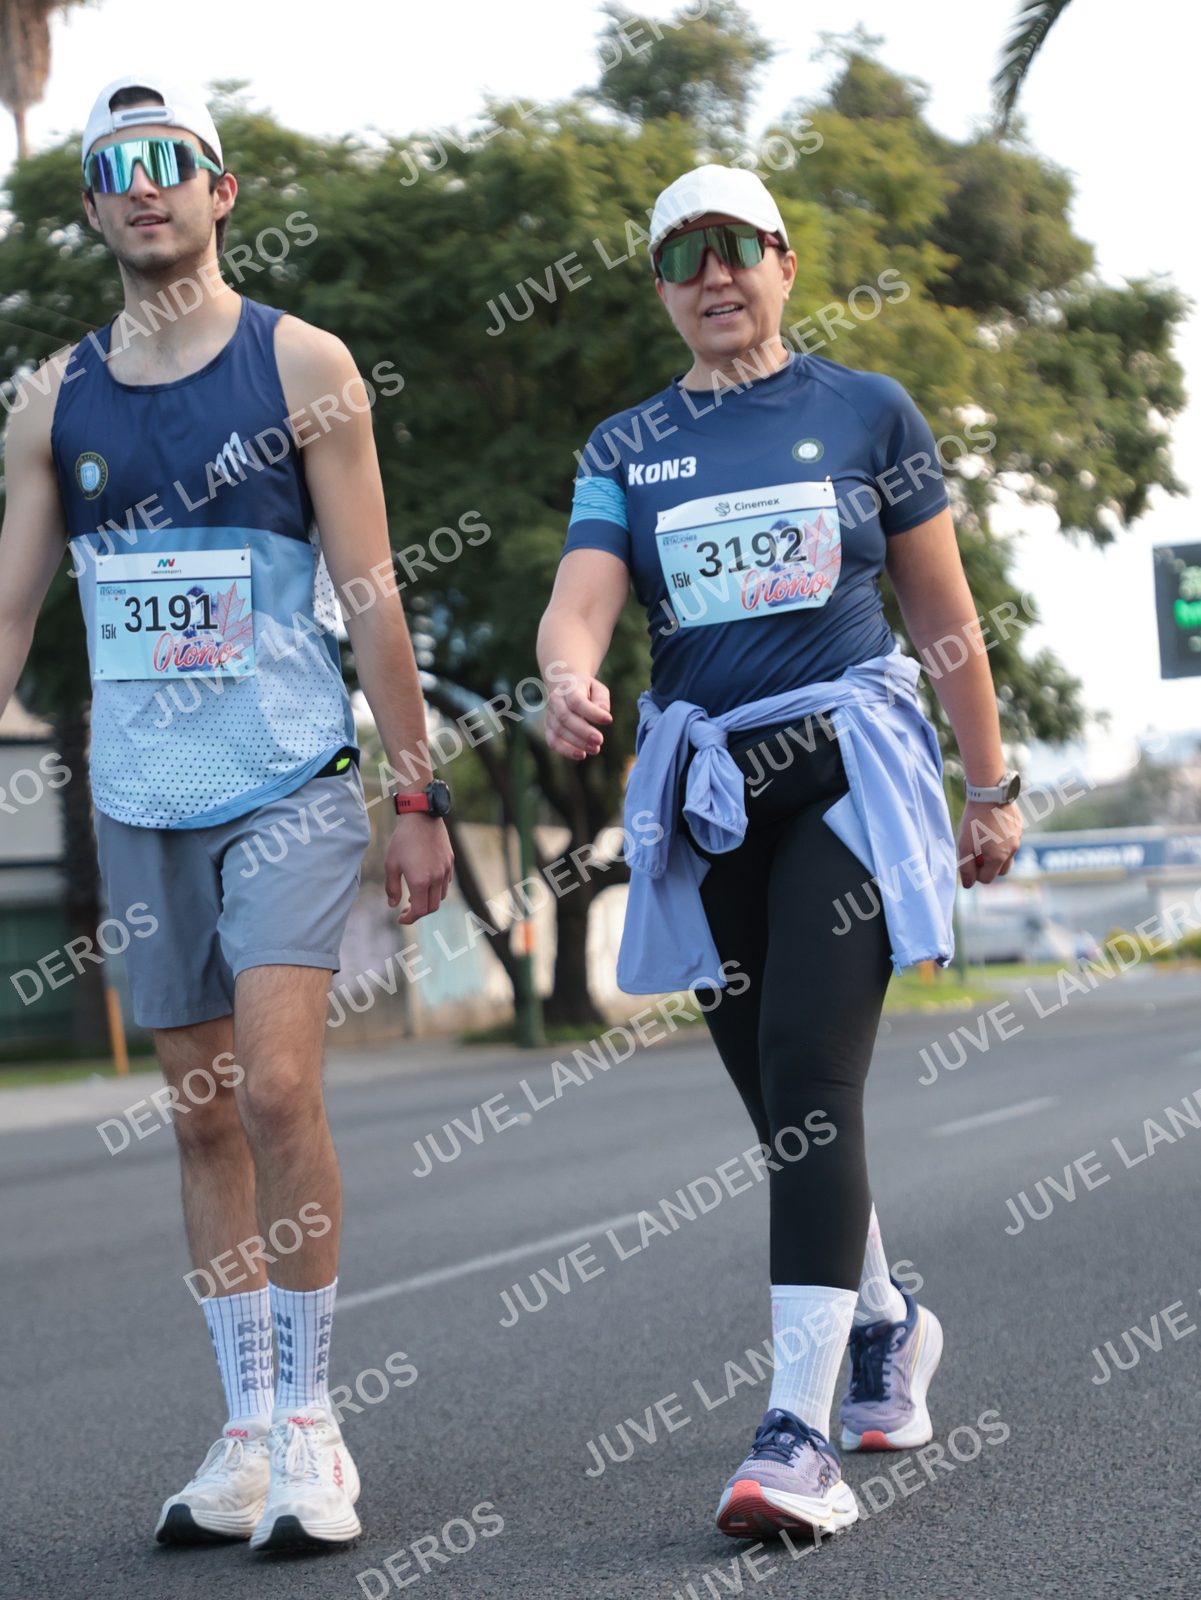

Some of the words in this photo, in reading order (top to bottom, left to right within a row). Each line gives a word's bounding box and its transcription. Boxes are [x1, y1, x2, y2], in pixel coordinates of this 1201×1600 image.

[628, 456, 697, 486] KON3
[734, 497, 780, 511] Cinemex
[696, 527, 807, 578] 3192
[671, 572, 692, 589] 15k
[124, 594, 218, 633] 3191
[101, 623, 117, 640] 15k
